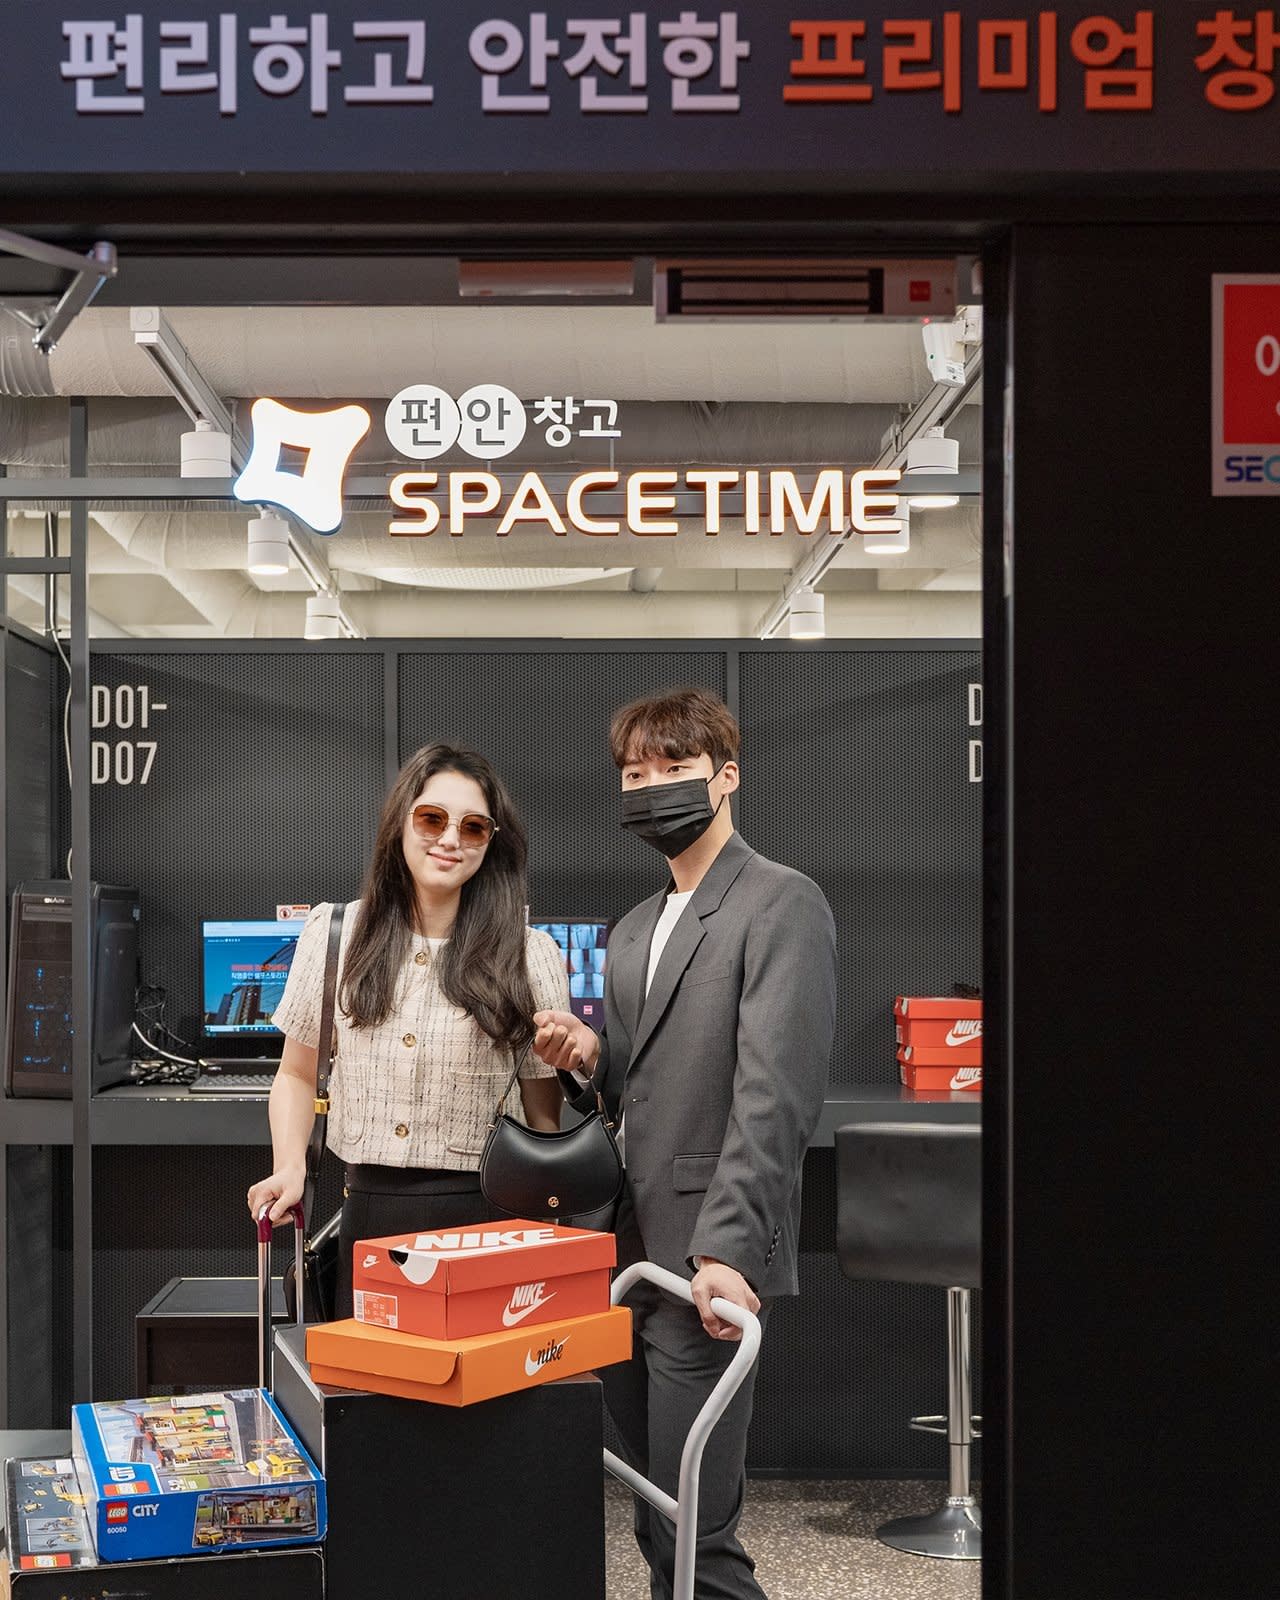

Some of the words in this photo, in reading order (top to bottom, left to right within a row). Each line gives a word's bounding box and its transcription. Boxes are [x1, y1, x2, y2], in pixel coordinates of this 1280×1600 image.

[59, 14, 434, 114] 편리하고
[468, 12, 751, 112] 안전한
[782, 11, 1154, 112] 프리미엄
[1194, 10, 1280, 111] 창
[388, 469, 903, 536] SPACETIME
[91, 684, 168, 729] D01-
[91, 741, 158, 785] D07
[952, 1019, 983, 1036] NIKE
[413, 1228, 555, 1250] NIKE
[510, 1281, 546, 1309] NIKE
[536, 1339, 564, 1366] nike
[107, 1506, 129, 1519] LEGO
[131, 1503, 160, 1518] CITY
[106, 1525, 128, 1535] 60050
